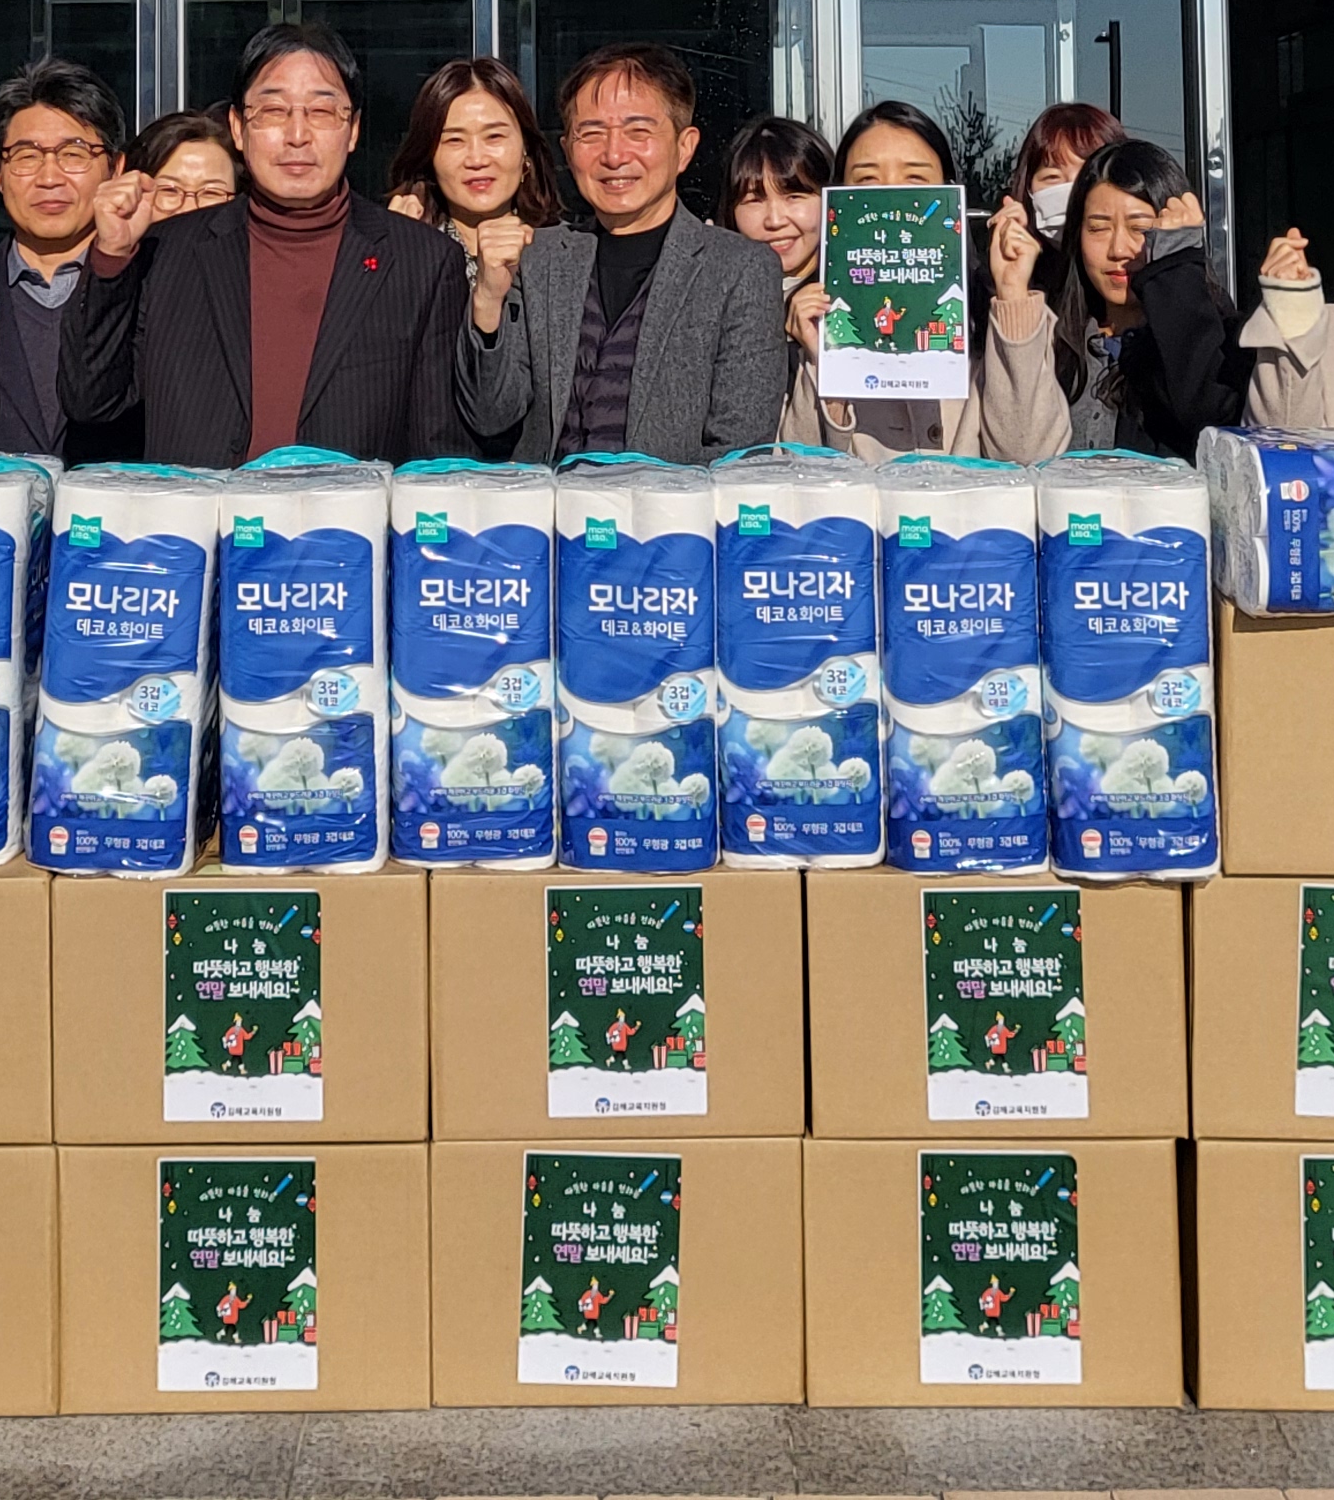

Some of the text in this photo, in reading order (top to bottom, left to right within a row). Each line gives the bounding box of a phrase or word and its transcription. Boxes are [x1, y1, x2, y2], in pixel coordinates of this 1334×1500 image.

[846, 248, 943, 266] 따뜻하고 행복한
[849, 268, 877, 285] 연말
[419, 577, 532, 607] 모나리자
[743, 569, 855, 600] 모나리자
[66, 581, 180, 618] 모나리자
[236, 582, 348, 611] 모나리자
[904, 582, 1016, 612] 모나리자
[1074, 579, 1190, 611] 모나리자
[432, 613, 520, 631] 데코&화이트
[756, 605, 844, 624] 데코&화이트
[76, 618, 165, 642] 데코&화이트
[917, 619, 1005, 636] 데코&화이트
[826, 669, 847, 683] 3겹
[318, 681, 338, 695] 3겹
[669, 685, 689, 700] 3겹
[988, 681, 1008, 696] 3겹
[192, 959, 299, 979] 따뜻하고 행복한
[575, 954, 682, 975] 따뜻하고 행복한
[952, 957, 1061, 978] 따뜻하고 행복한
[195, 982, 226, 1000] 연말
[578, 978, 609, 996] 연말
[956, 981, 987, 999] 연말
[187, 1228, 294, 1247] 따뜻하고 행복한
[550, 1223, 658, 1244] 따뜻하고 행복한
[948, 1221, 1057, 1241] 따뜻하고 행복한
[190, 1250, 220, 1269] 연말
[553, 1245, 584, 1263] 연말
[951, 1243, 982, 1261] 연말
